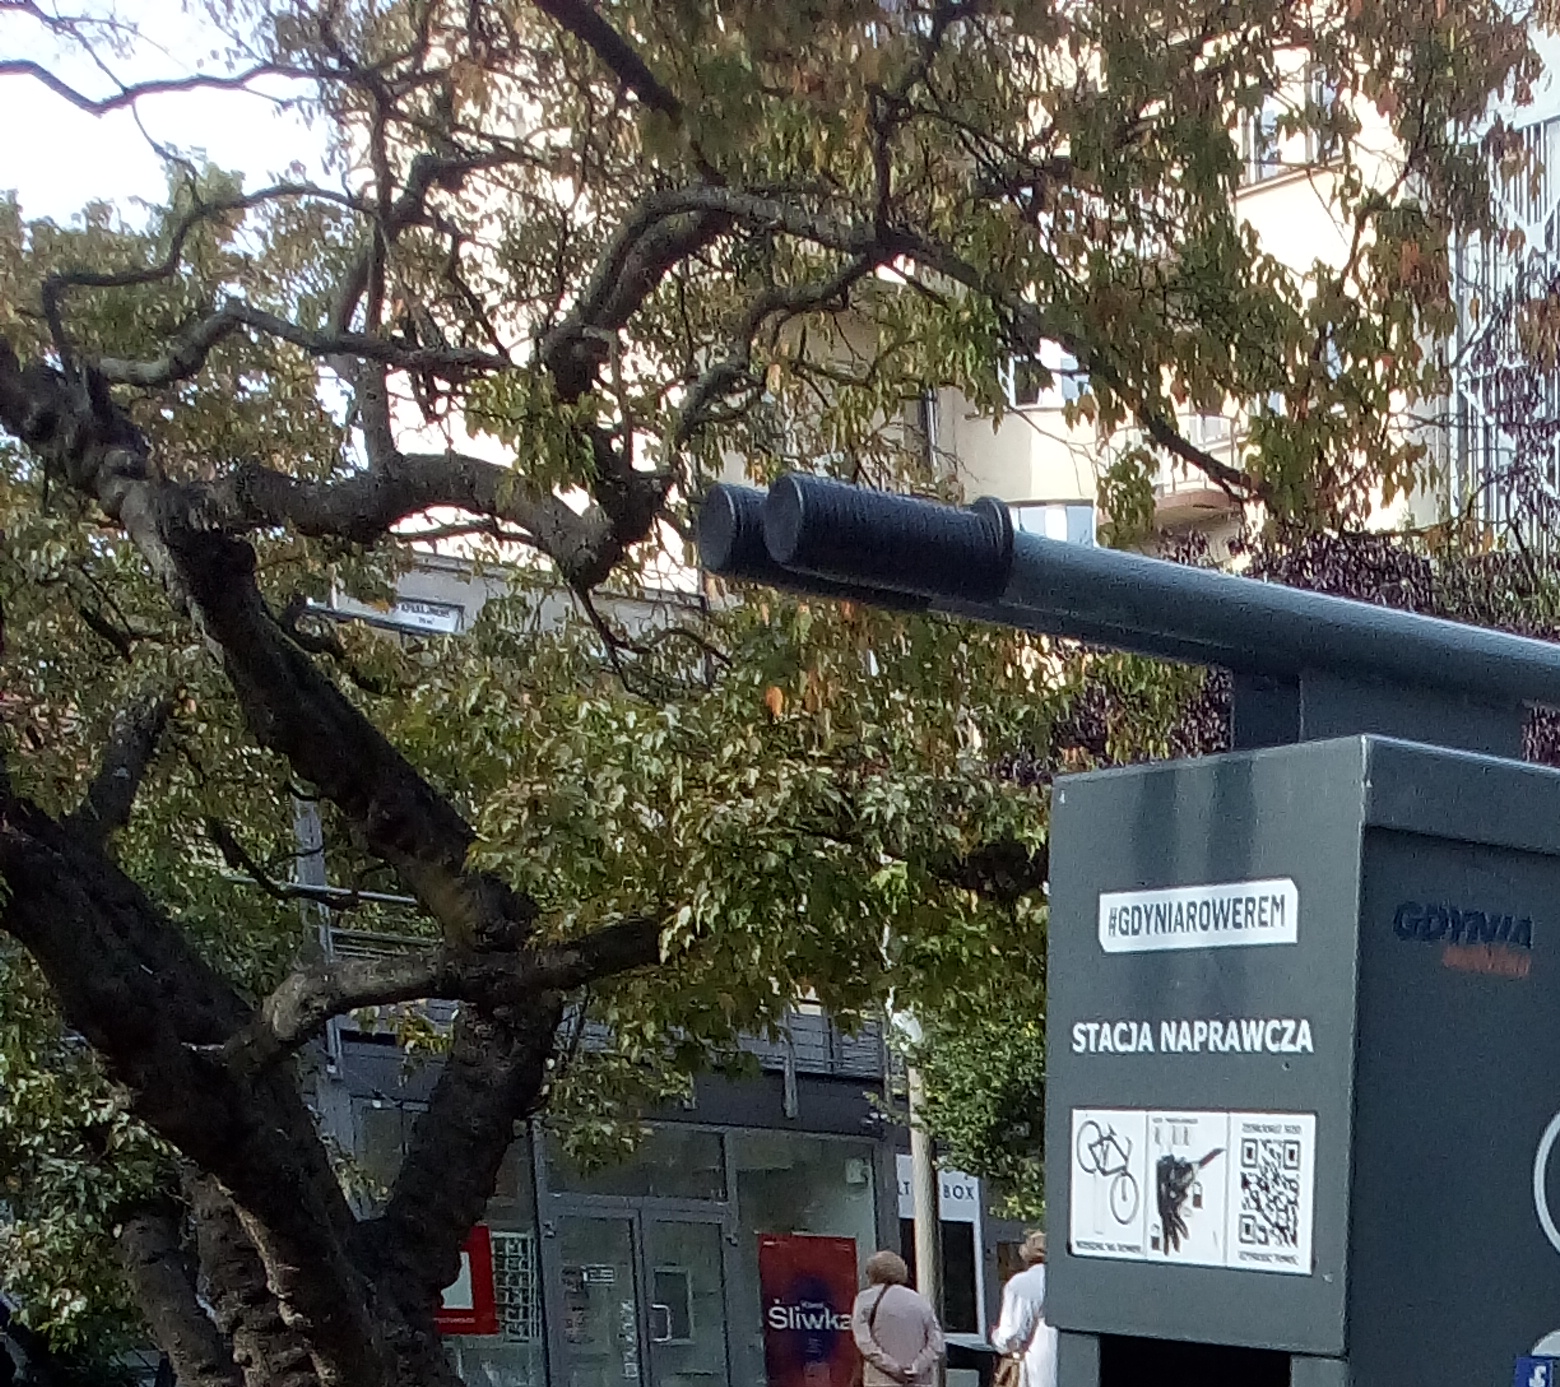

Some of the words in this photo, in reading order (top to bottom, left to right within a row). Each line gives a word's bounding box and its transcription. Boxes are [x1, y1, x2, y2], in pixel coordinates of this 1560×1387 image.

[1108, 893, 1286, 937] #GDYNIAROWEREM
[1392, 901, 1533, 949] GDYNIA
[1071, 1021, 1155, 1052] STACJA
[1160, 1018, 1315, 1054] NAPRAWCZA
[943, 1183, 975, 1200] BOX
[768, 1298, 852, 1330] Śliwka
